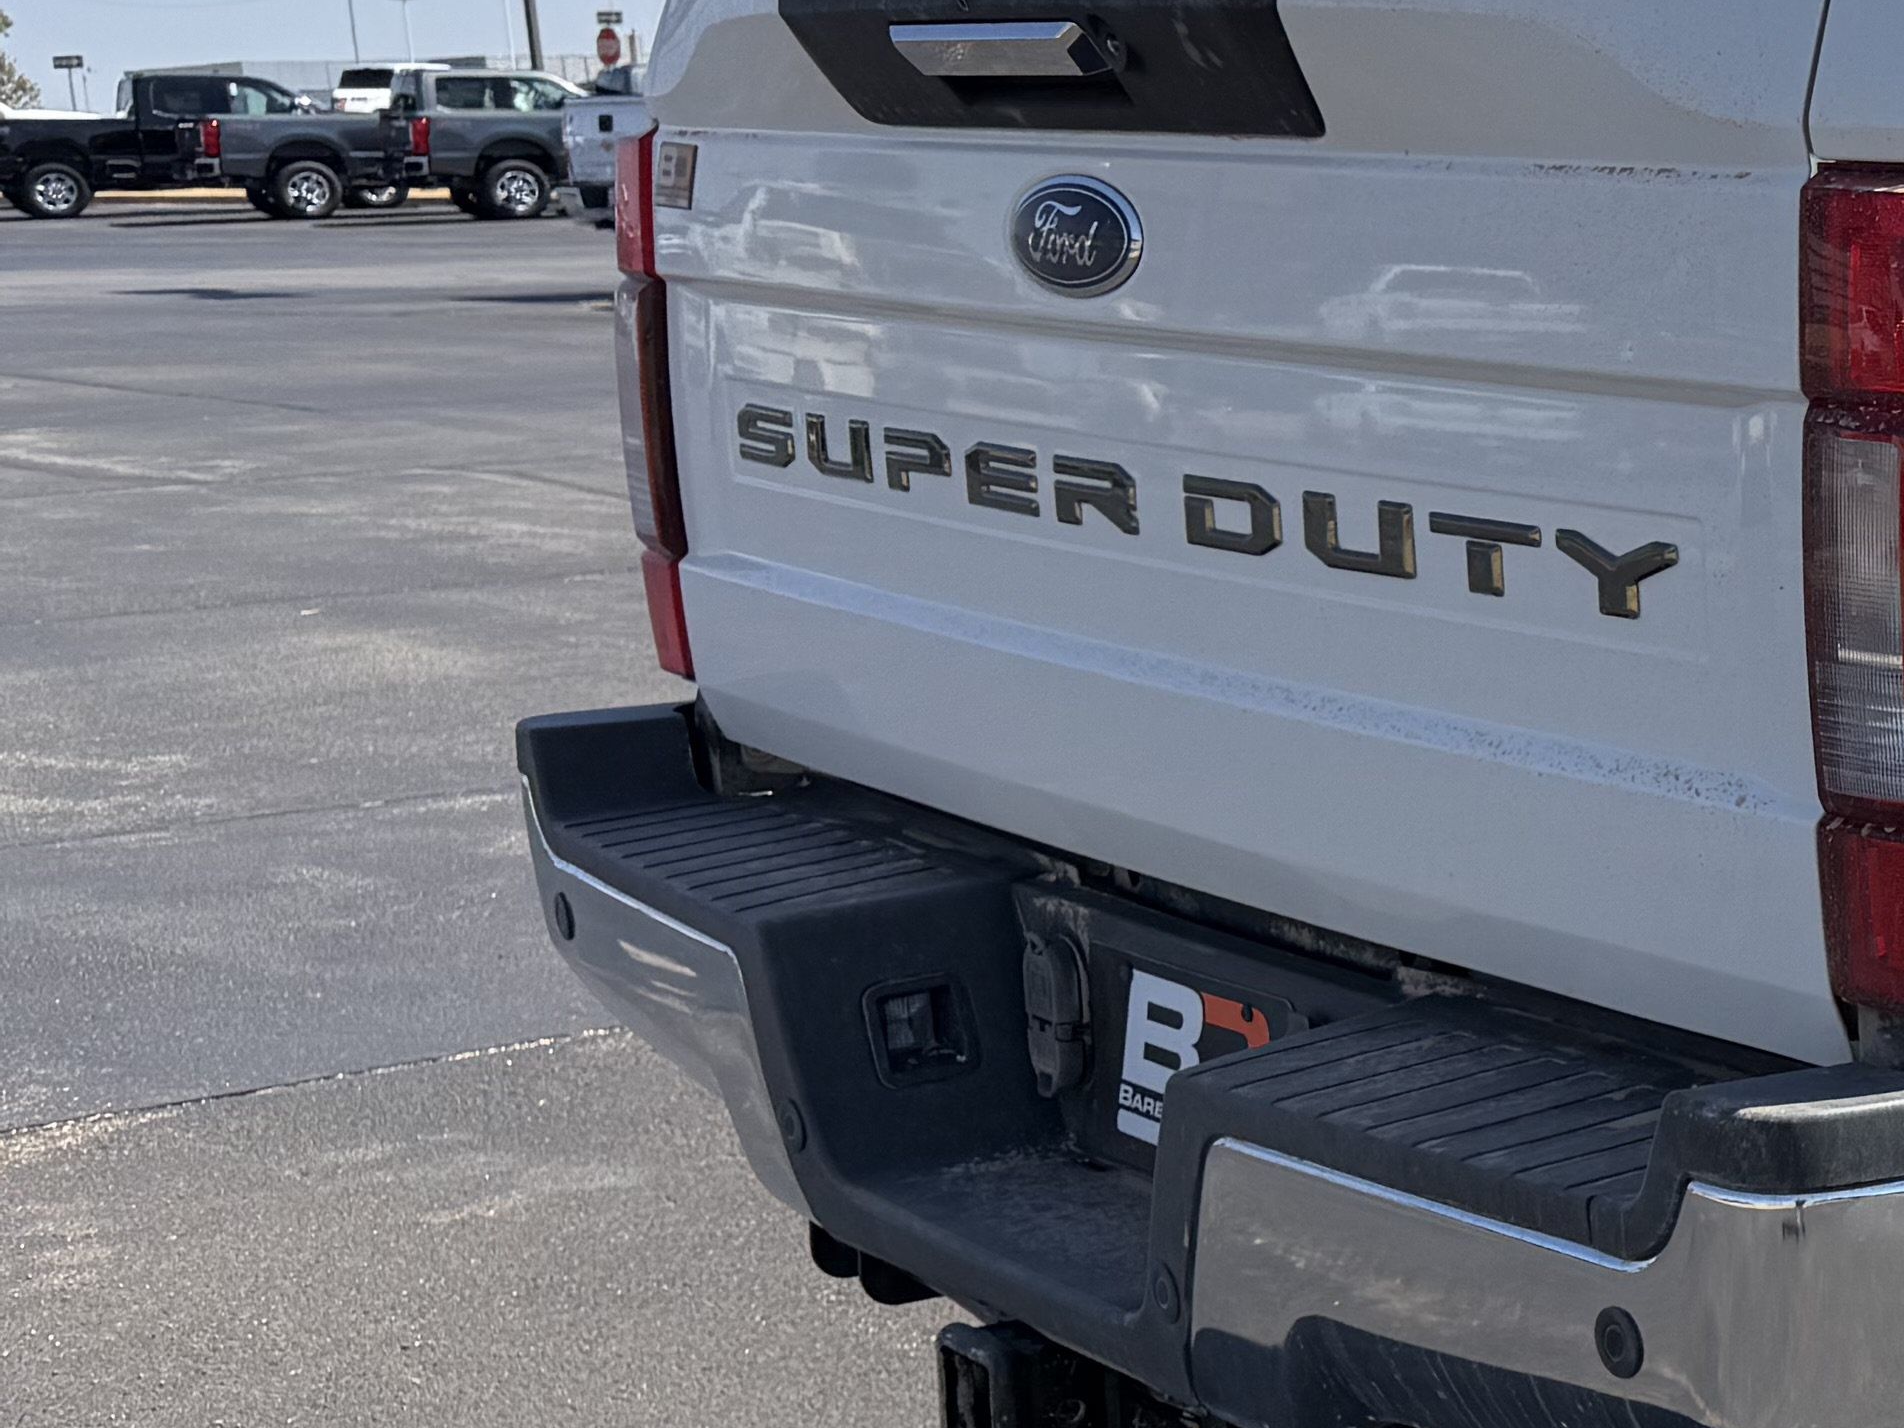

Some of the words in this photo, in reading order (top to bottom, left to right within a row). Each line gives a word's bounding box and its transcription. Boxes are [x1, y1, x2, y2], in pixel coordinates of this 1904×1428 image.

[1028, 200, 1098, 266] Ford
[737, 403, 1140, 535] SUPER
[1183, 473, 1679, 619] DUTY
